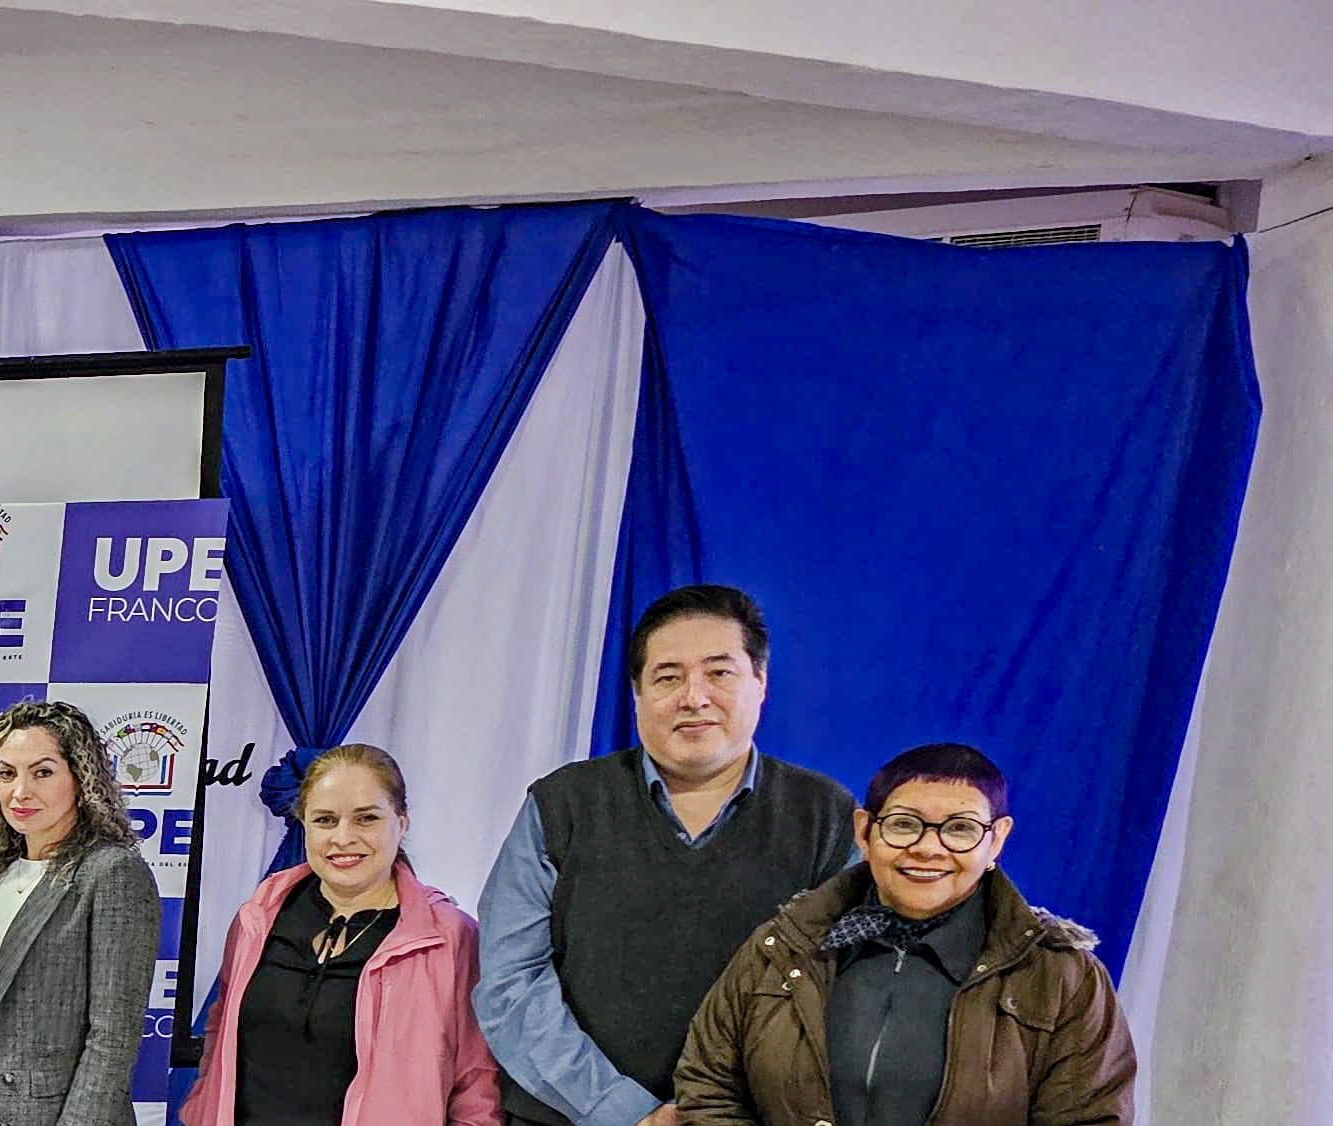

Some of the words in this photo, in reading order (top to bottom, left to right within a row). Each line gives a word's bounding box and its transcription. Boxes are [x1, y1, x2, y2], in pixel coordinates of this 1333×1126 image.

[93, 537, 227, 592] UPE
[88, 597, 218, 622] FRANCO
[143, 710, 153, 719] ES
[154, 711, 188, 736] LIBERTAD
[125, 808, 195, 855] PE
